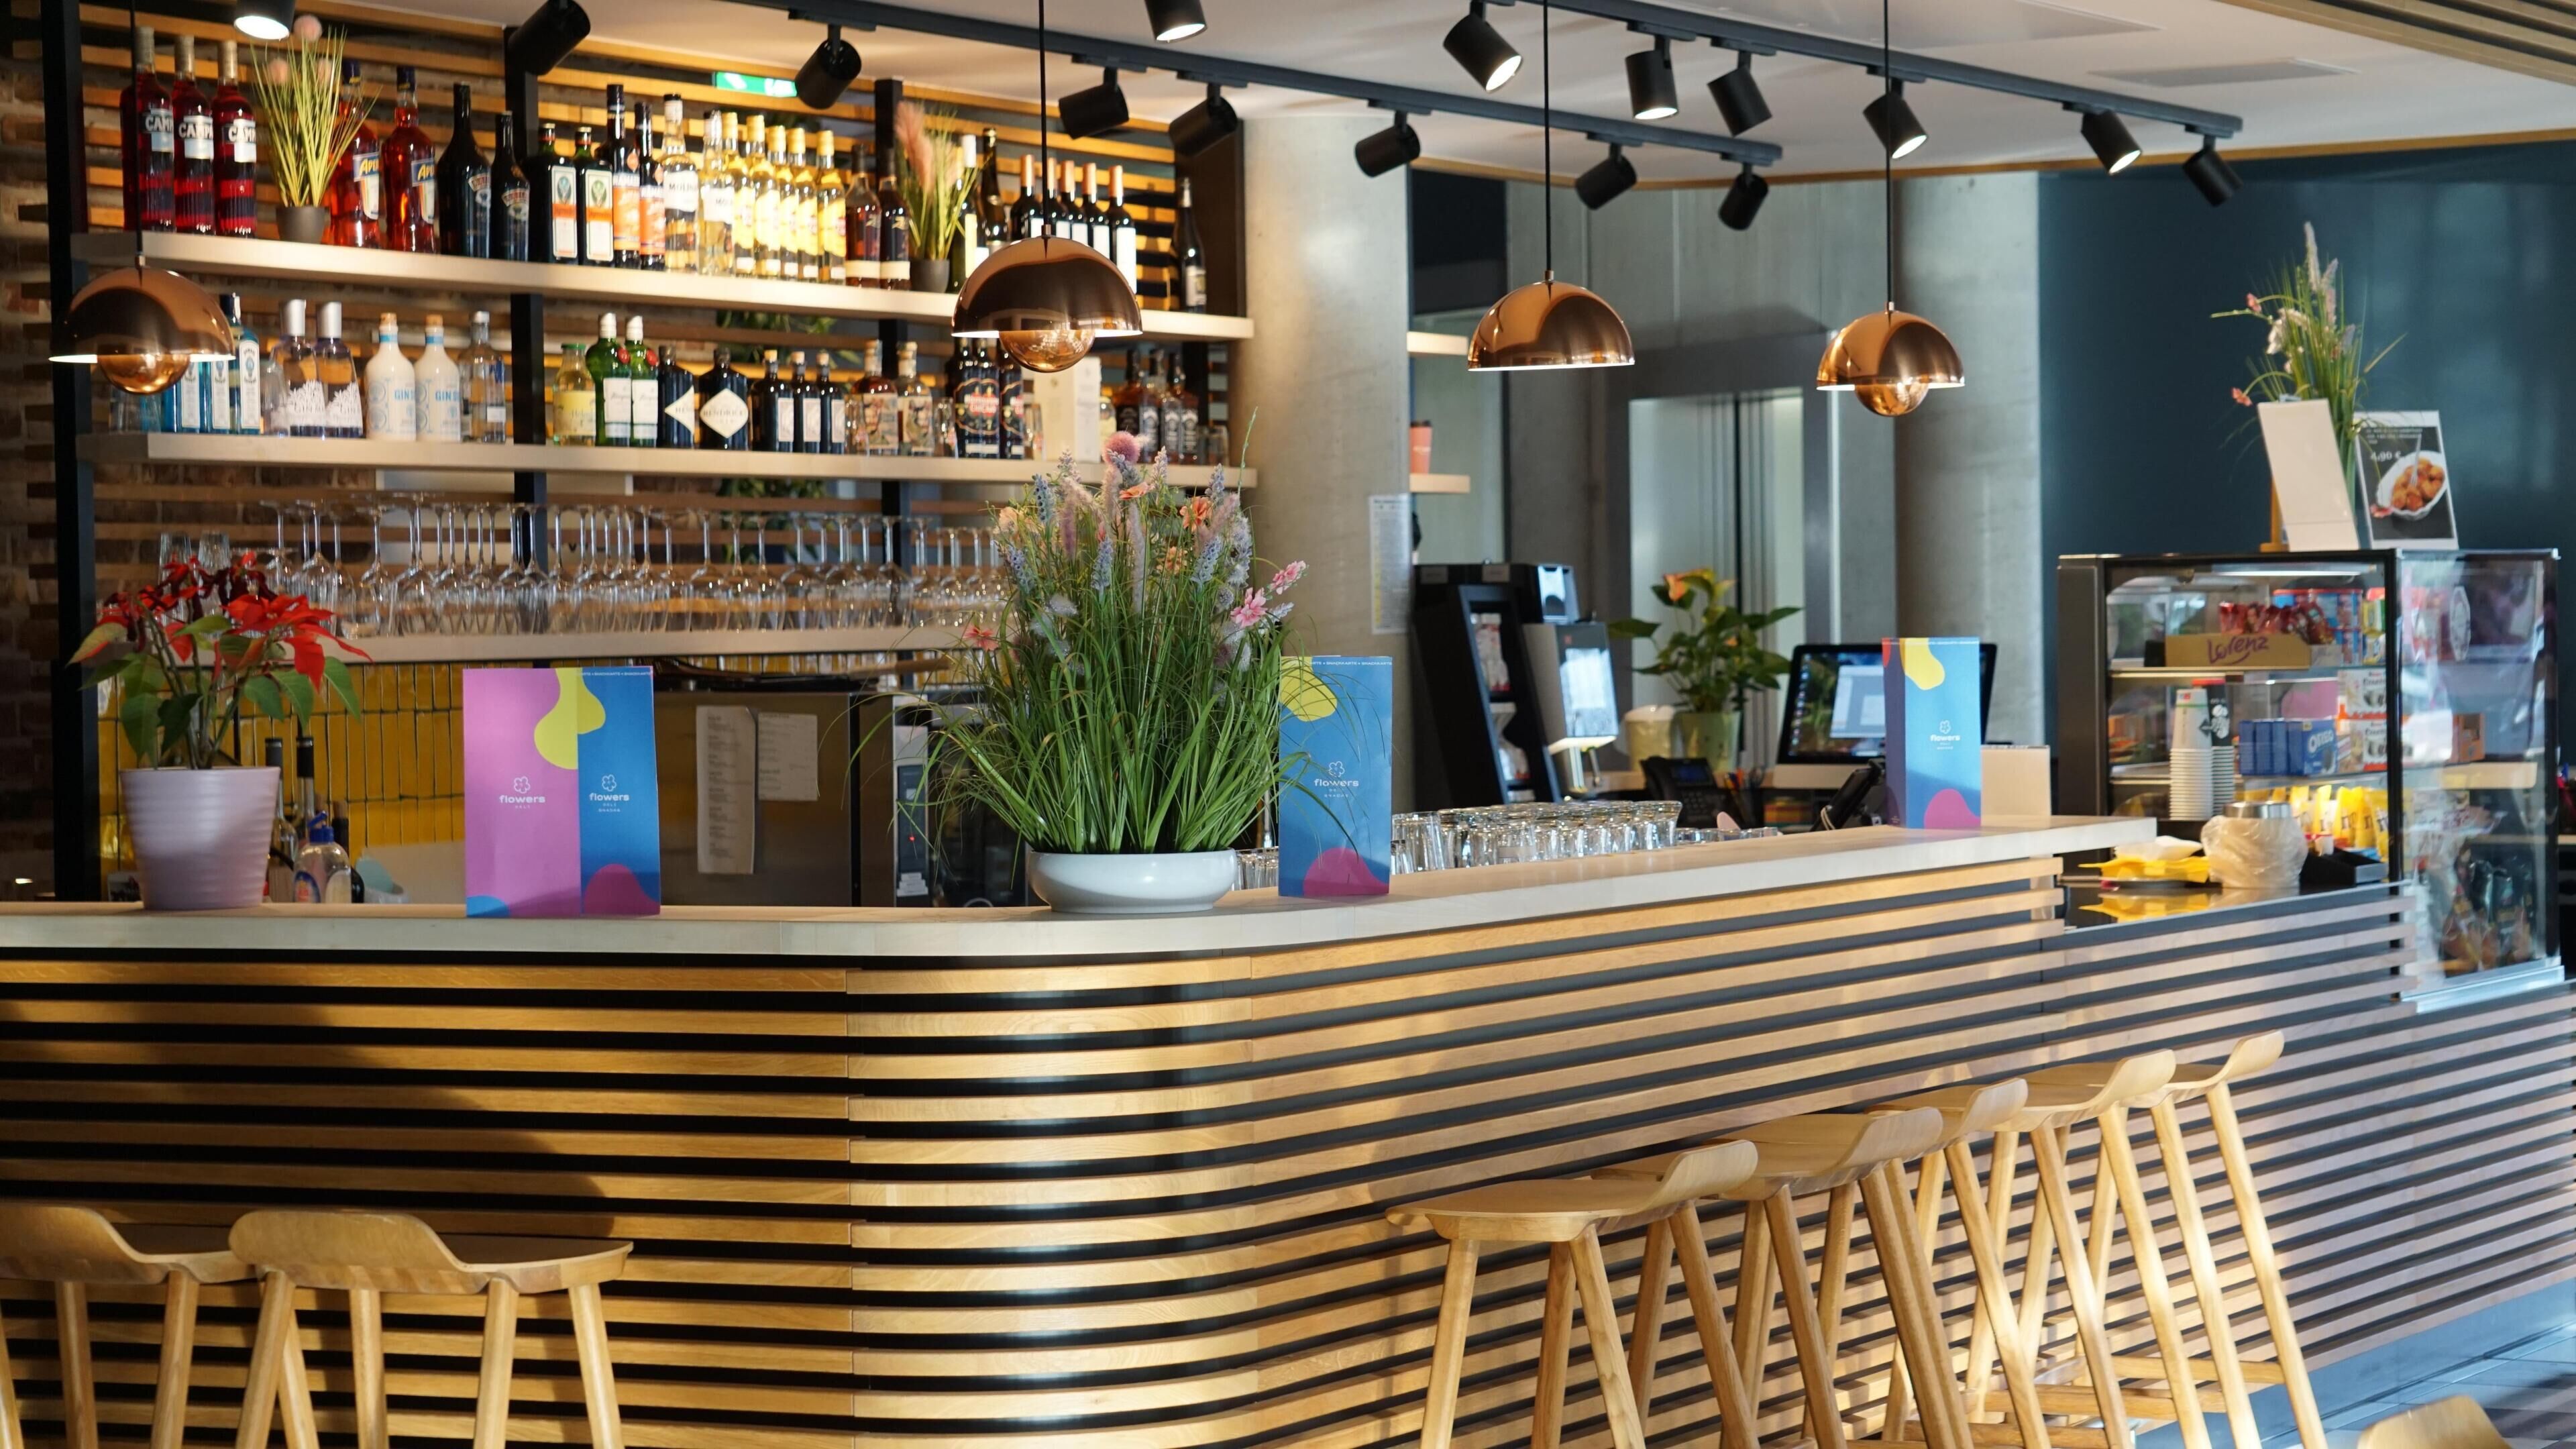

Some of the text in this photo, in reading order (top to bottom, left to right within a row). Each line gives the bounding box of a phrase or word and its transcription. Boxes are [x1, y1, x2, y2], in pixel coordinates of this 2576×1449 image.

[2206, 636, 2269, 665] Lorenz
[1313, 779, 1359, 787] flowers
[499, 795, 546, 804] flowers
[589, 792, 630, 802] flowers
